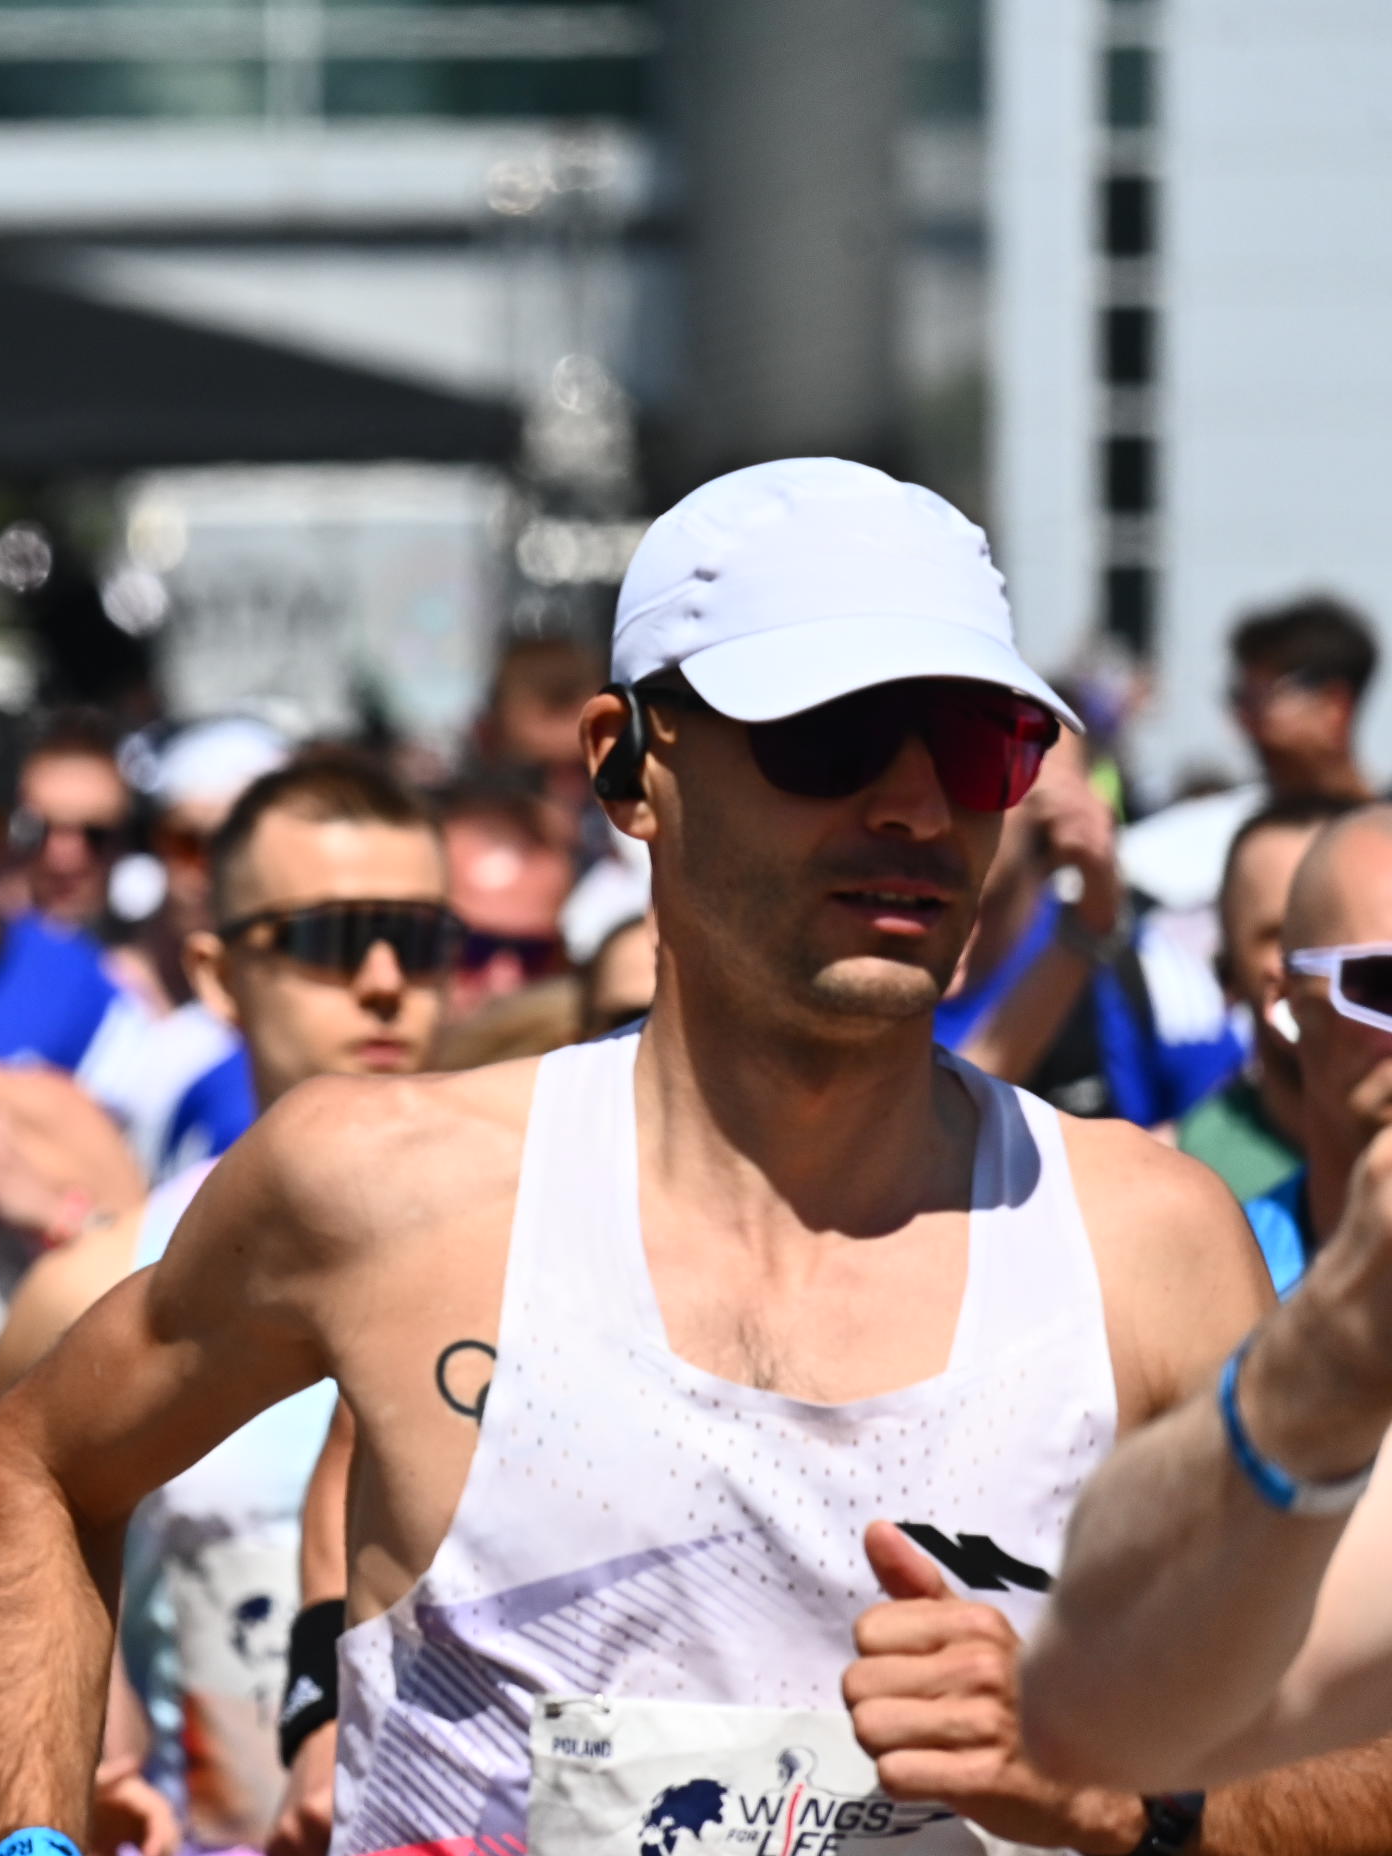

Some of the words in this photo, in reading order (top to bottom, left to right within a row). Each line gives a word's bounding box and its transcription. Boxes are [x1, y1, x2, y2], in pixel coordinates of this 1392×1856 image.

[552, 1737, 611, 1758] POLAND
[740, 1795, 895, 1832] WINGS
[727, 1829, 758, 1842] FOR
